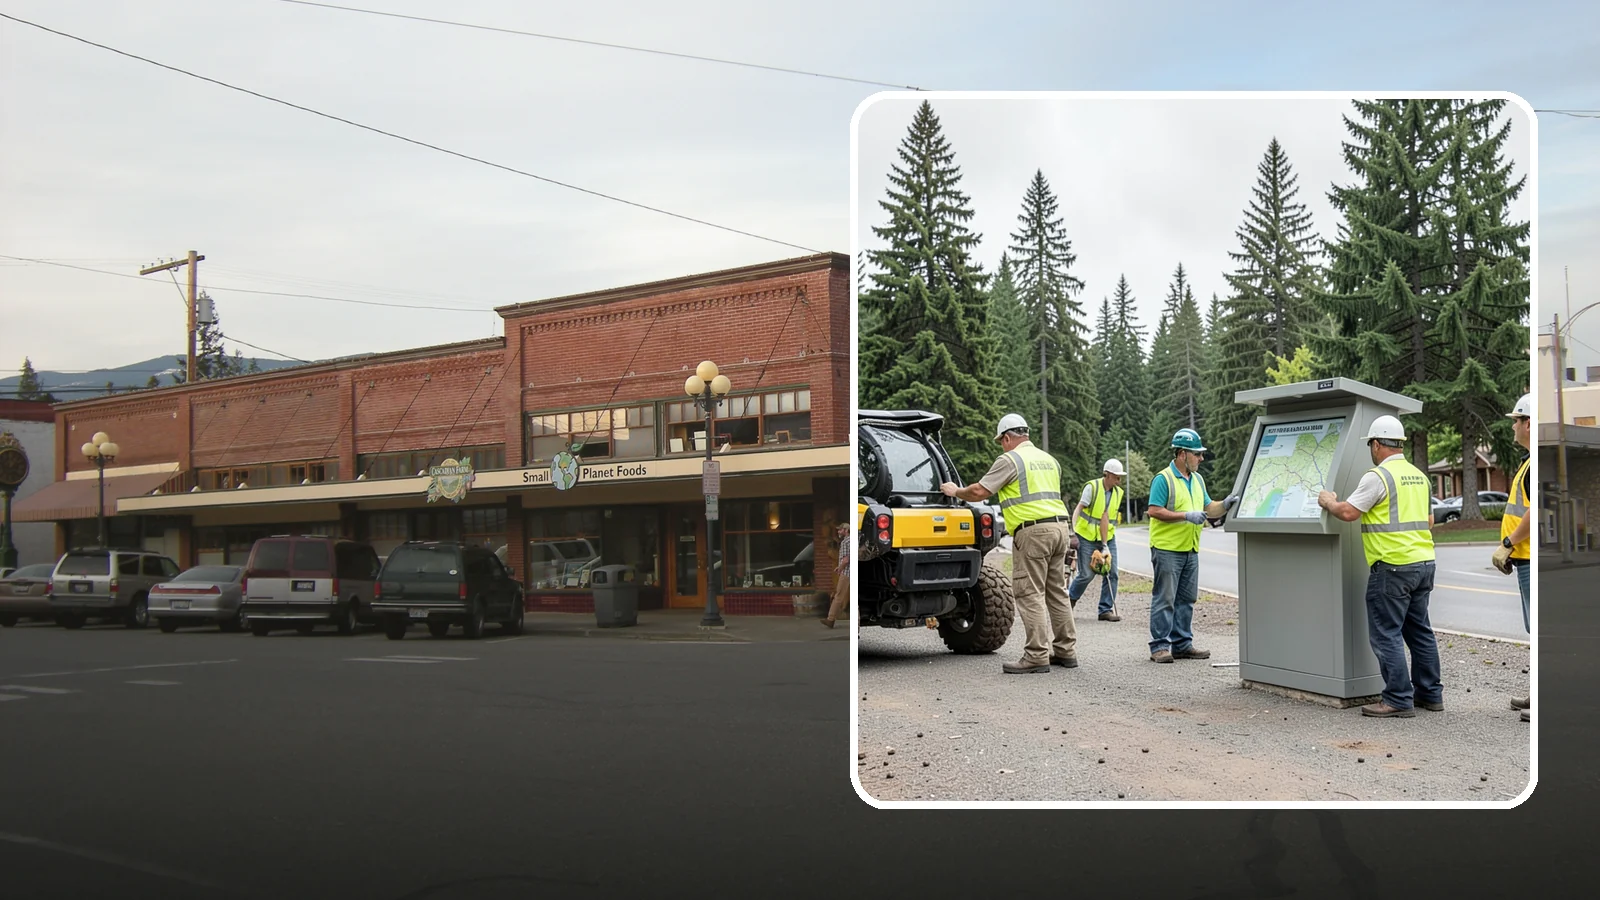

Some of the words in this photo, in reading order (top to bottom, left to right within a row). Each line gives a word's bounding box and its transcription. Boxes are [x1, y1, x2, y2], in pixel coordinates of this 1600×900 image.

[431, 467, 456, 475] CASCADIAN
[456, 466, 469, 474] FARM
[523, 471, 549, 483] Small
[583, 467, 614, 479] Planet
[616, 464, 647, 477] Foods
